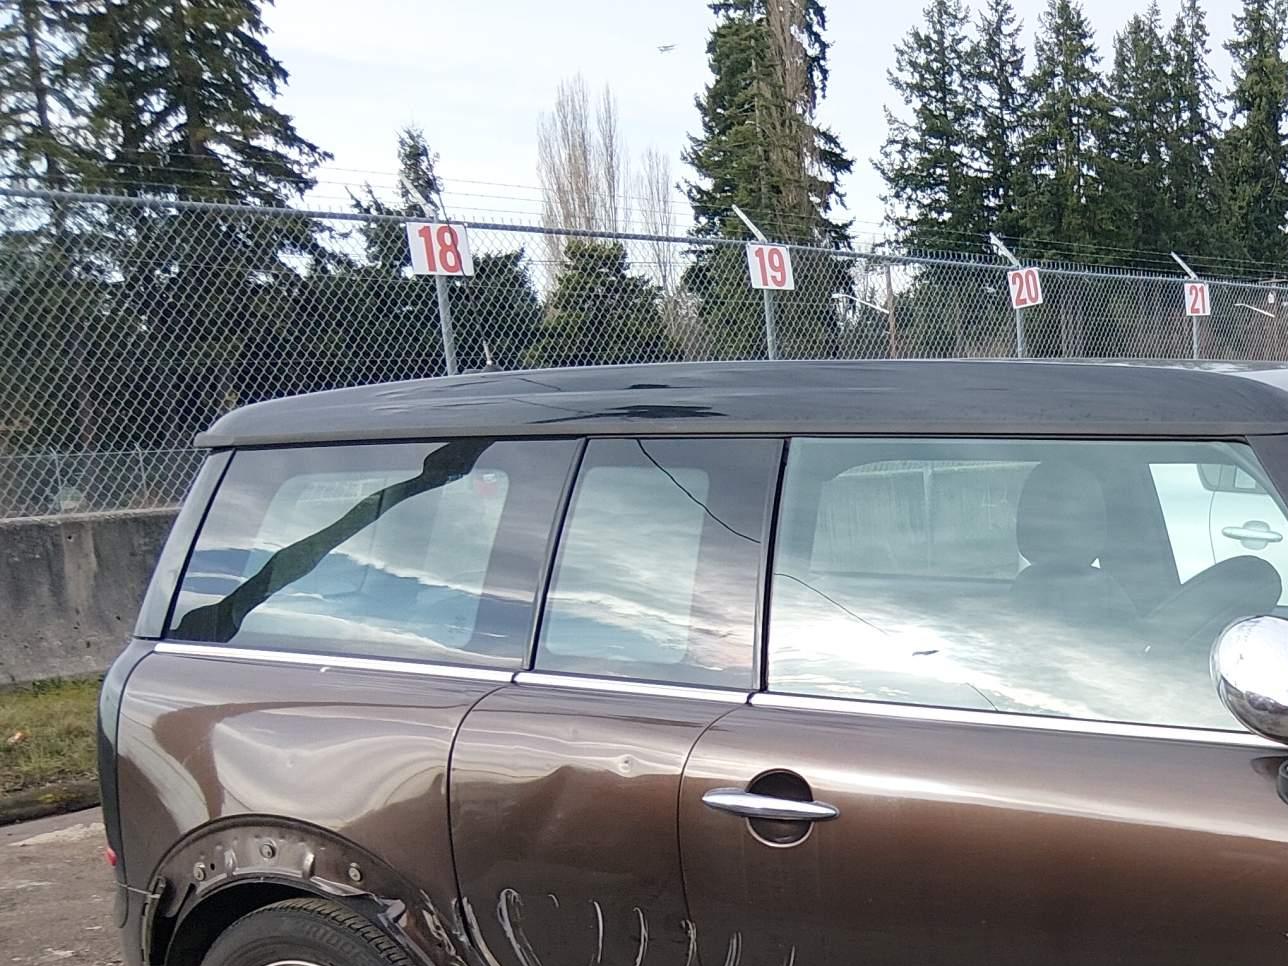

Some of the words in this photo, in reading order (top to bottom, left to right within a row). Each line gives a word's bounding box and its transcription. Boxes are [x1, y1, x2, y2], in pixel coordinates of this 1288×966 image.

[417, 224, 463, 275] 18
[754, 247, 787, 288] 19
[1011, 269, 1040, 307] 20
[1188, 285, 1207, 315] 21
